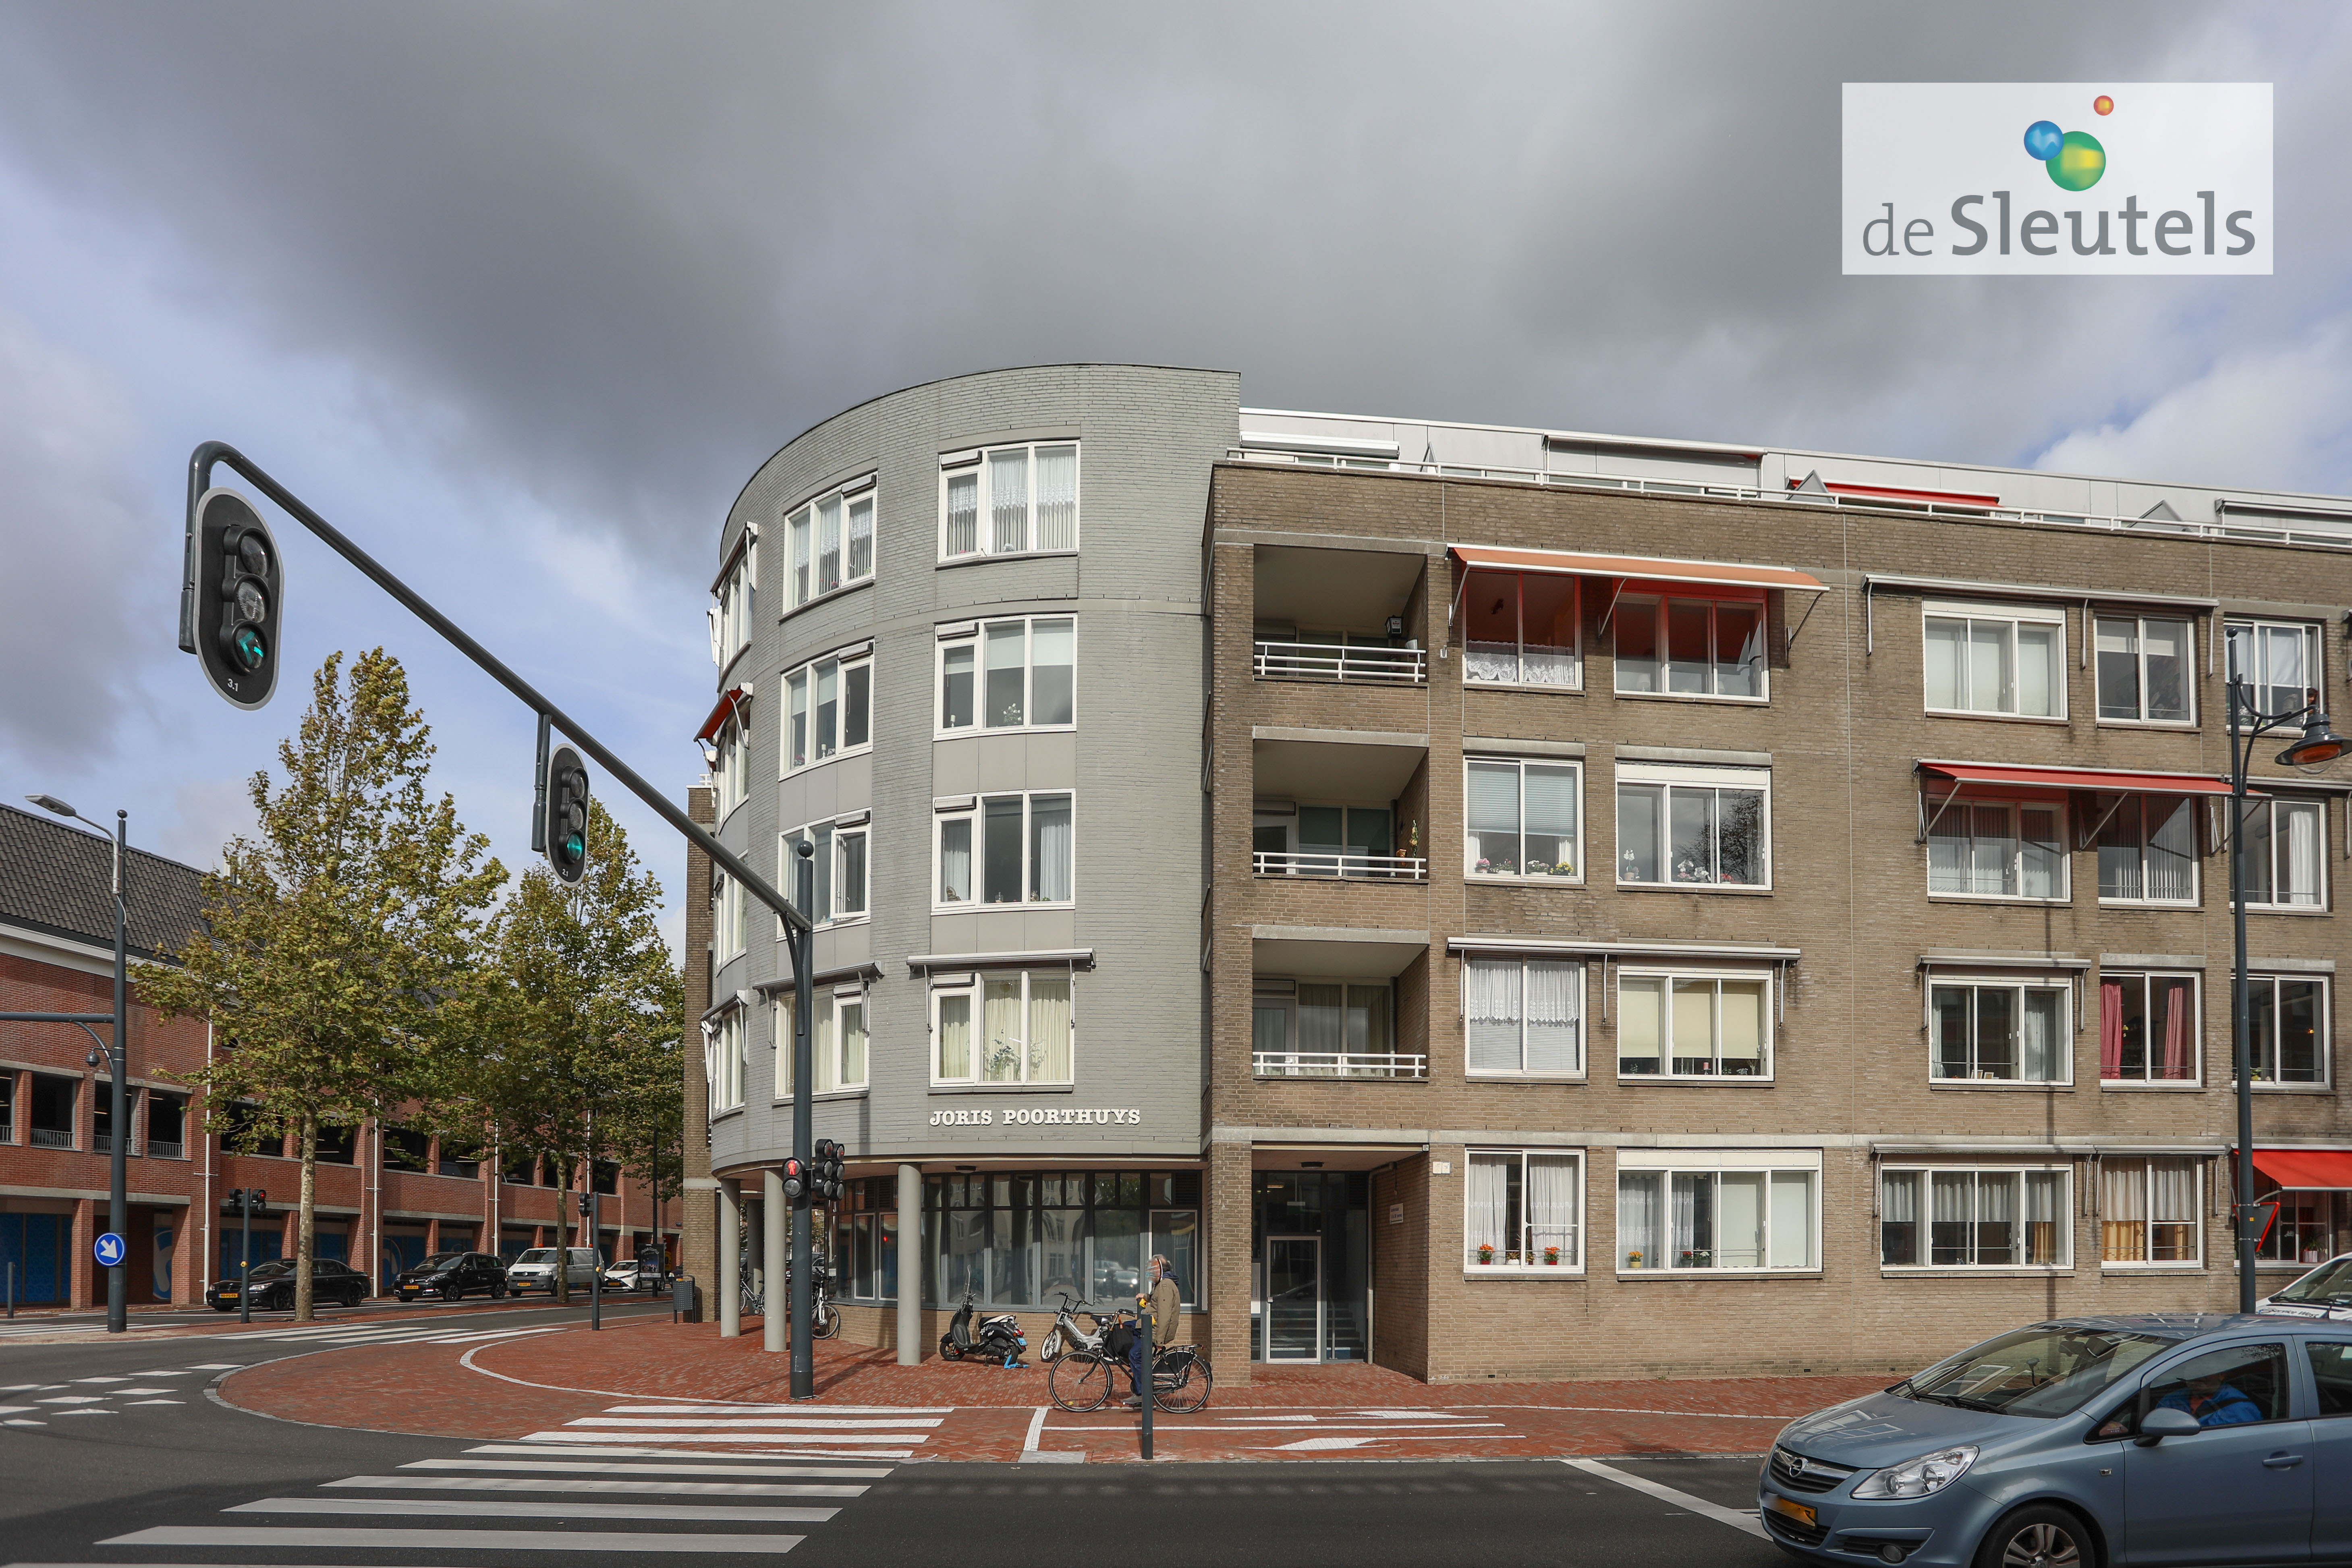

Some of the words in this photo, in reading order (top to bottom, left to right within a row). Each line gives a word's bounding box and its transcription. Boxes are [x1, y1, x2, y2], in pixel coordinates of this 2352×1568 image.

[228, 678, 238, 692] 3.1
[929, 1110, 992, 1126] JORIS
[1003, 1109, 1140, 1125] POORTHUYS
